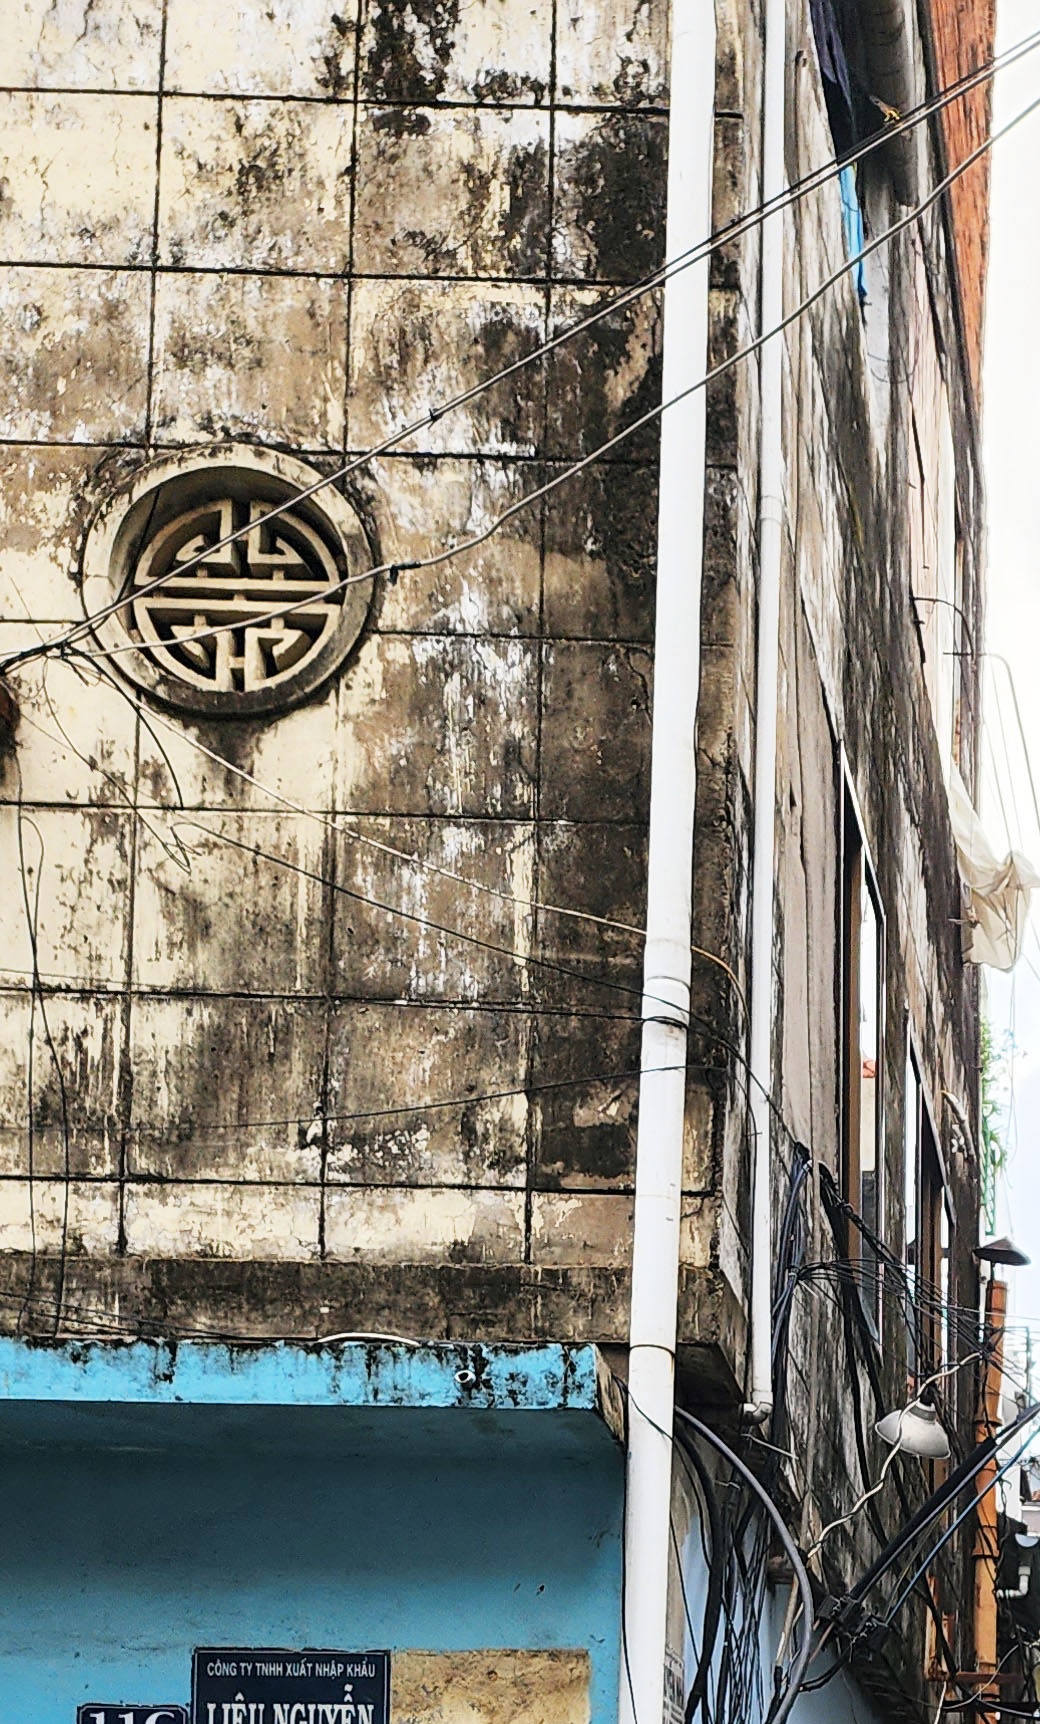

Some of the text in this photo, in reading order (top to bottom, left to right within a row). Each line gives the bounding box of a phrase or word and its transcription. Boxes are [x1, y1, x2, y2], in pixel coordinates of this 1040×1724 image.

[207, 1656, 376, 1680] CÔNG TY TNHH XUẤT NHẬP KHẨU
